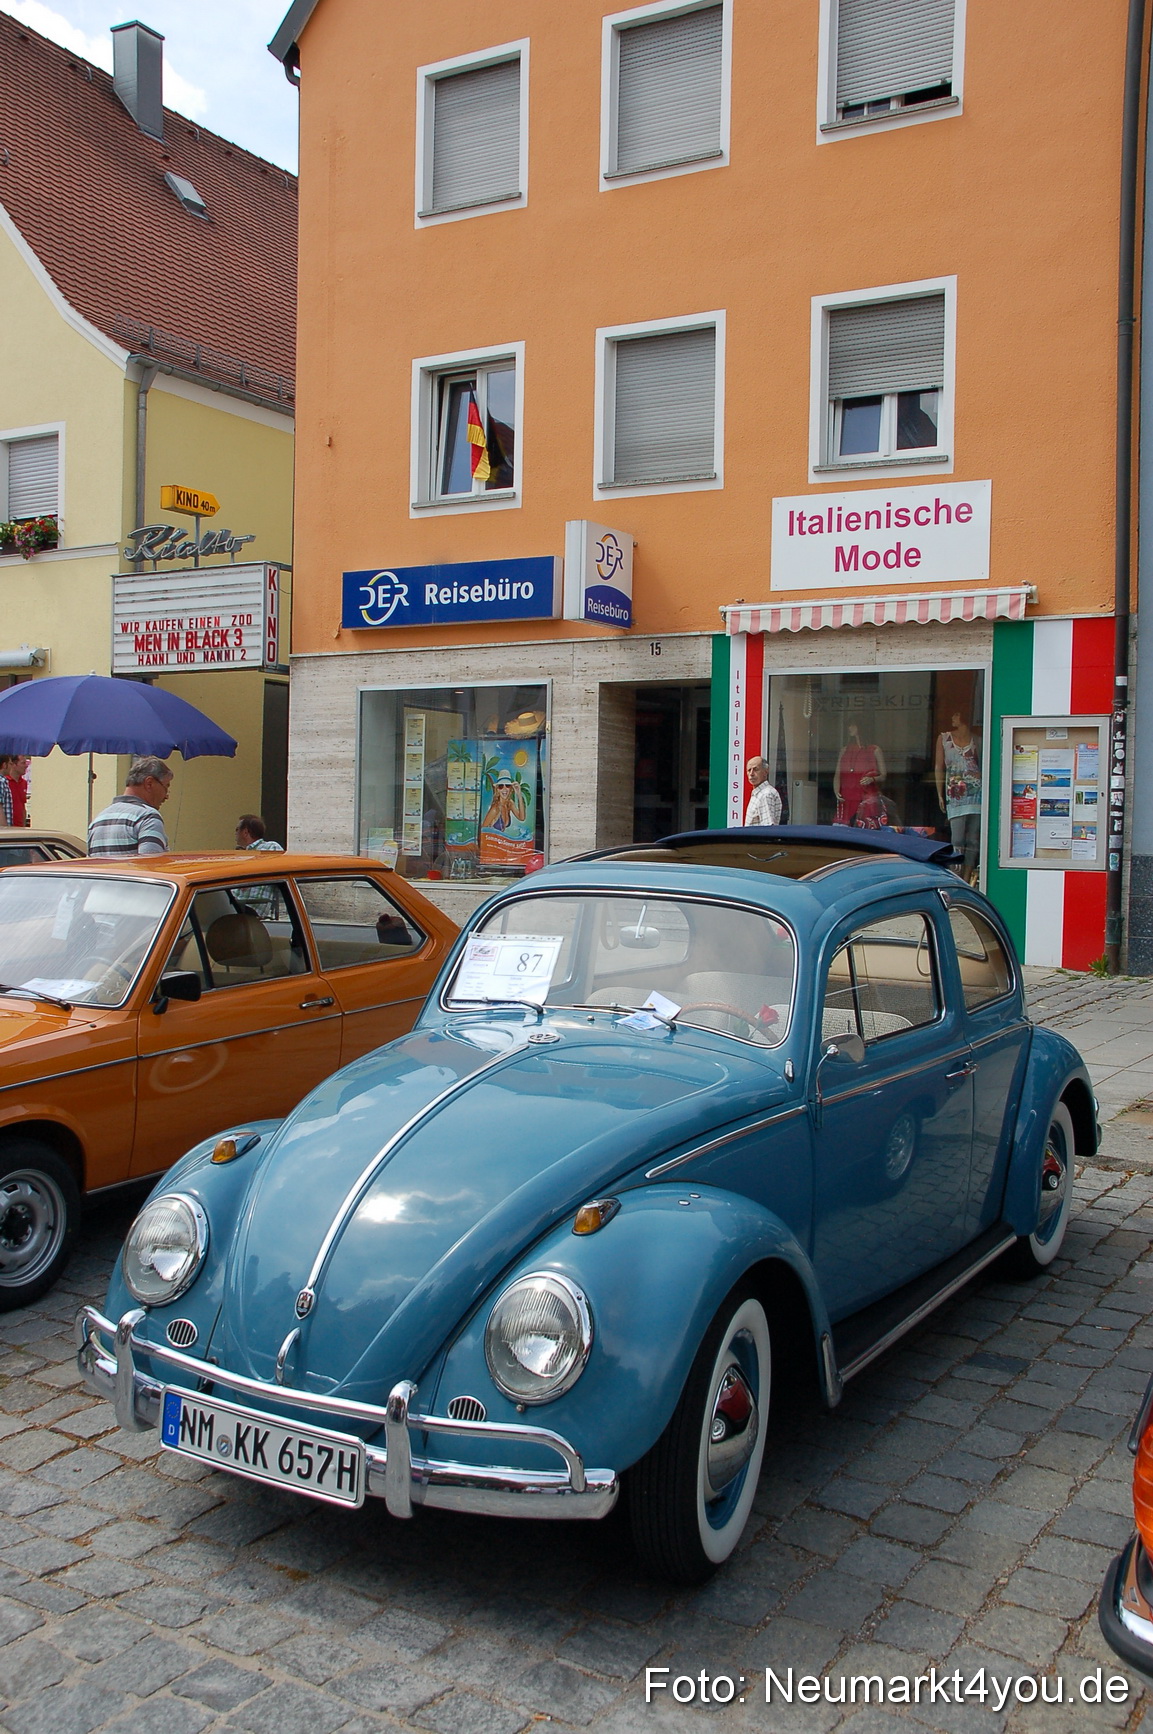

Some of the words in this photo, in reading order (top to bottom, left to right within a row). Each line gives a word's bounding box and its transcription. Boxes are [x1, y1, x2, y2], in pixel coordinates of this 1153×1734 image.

[175, 489, 199, 509] KINO
[788, 498, 974, 537] Italienische
[123, 524, 257, 562] Rialto
[834, 541, 922, 573] Mode
[425, 578, 534, 605] Reisebüro
[267, 568, 278, 663] KINO
[587, 597, 630, 622] Reisebüro
[121, 620, 140, 634] WIR
[145, 617, 184, 633] KAUFEN
[189, 615, 221, 629] EINEN
[231, 613, 253, 627] ZOO
[134, 632, 162, 653] MEN
[167, 632, 180, 651] IN
[185, 628, 230, 650] BLACK
[234, 628, 243, 647] 3
[650, 642, 661, 656] 15
[138, 652, 169, 666] HANNI
[176, 651, 195, 664] UND
[203, 649, 235, 663] NANNI
[240, 648, 247, 661] 2
[731, 669, 741, 828] Italienisch
[516, 952, 544, 973] 87
[168, 1424, 175, 1436] D
[180, 1404, 215, 1451] NM
[234, 1421, 270, 1470] KK
[278, 1436, 357, 1492] 657H
